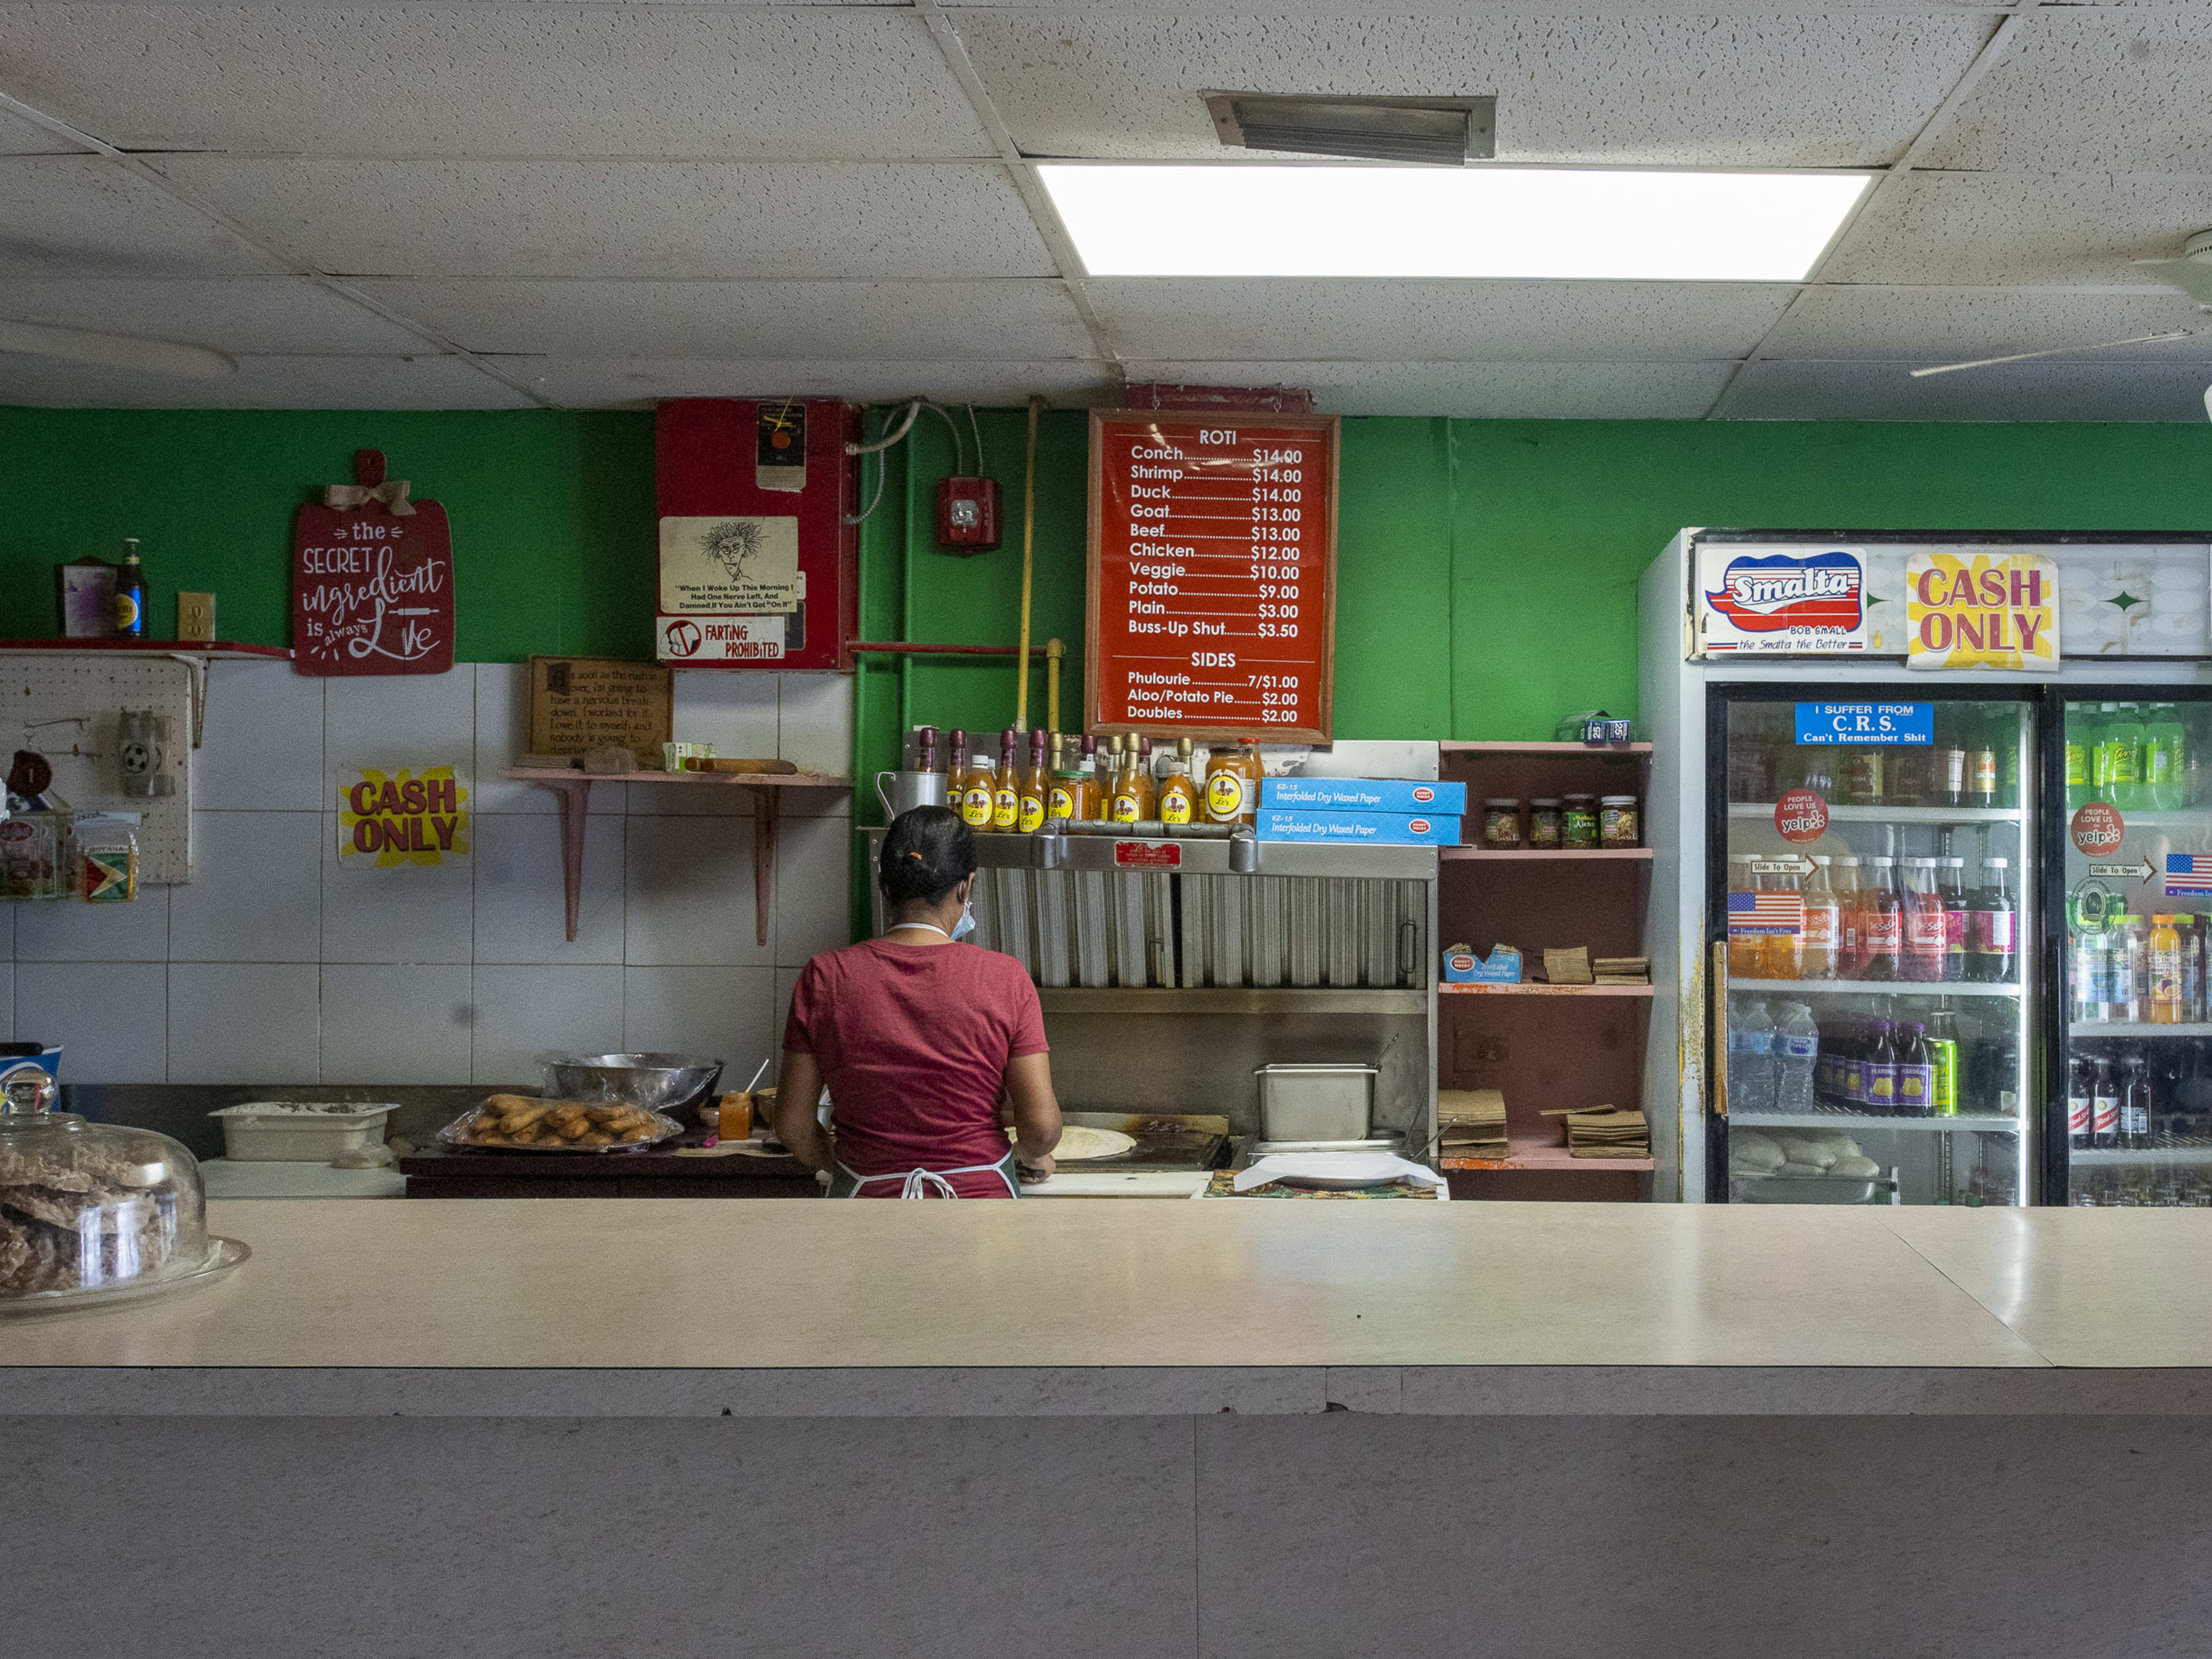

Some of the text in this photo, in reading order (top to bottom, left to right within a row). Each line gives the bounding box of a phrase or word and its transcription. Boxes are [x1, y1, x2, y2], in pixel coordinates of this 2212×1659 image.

[1199, 430, 1236, 445] ROTI
[1131, 446, 1302, 463] Conch $14.00
[1131, 465, 1301, 483] Shrimp $14.00
[1131, 486, 1301, 503] Duck $14.00
[1130, 505, 1300, 522] Goat $13.00
[353, 522, 385, 539] the
[1130, 524, 1300, 541] Beef $13.00
[304, 547, 372, 574] SECRET
[1130, 543, 1300, 561] Chicken $12.00
[1130, 562, 1299, 581] Veggie $10.00
[302, 546, 445, 626] ingredient
[1129, 582, 1298, 599] Potato $9.00
[1732, 567, 1851, 603] Smalta
[1917, 568, 2041, 608] CASH
[1129, 601, 1298, 619] Plain $3.00
[307, 618, 323, 636] is
[325, 623, 368, 646] always
[1129, 620, 1297, 638] Buss-Up Shut $3.50
[1790, 627, 1846, 635] BOB SMALL
[1919, 612, 2043, 652] ONLY
[1740, 639, 1847, 650] the Smalta the Better
[1191, 652, 1235, 668] SIDES
[1128, 672, 1298, 689] Phulourie 7/$1.00
[607, 685, 632, 696] going
[1128, 689, 1297, 706] Aloo/Potato Pie $2.00
[551, 695, 570, 704] have
[588, 707, 623, 717] worked
[627, 709, 638, 717] for
[1128, 706, 1297, 722] Doubles $2.00
[1816, 706, 1913, 714] I SUFFER FROM
[575, 721, 583, 729] it
[586, 721, 596, 729] to
[634, 722, 652, 730] and
[550, 732, 585, 742] nobody
[599, 735, 626, 747] going
[630, 733, 641, 741] to
[1804, 733, 1926, 742] Can't Remember Shit
[350, 779, 456, 816] CASH
[1277, 791, 1316, 802] Interfolded
[1317, 792, 1332, 804] Dry
[1334, 793, 1359, 802] Waxed
[1360, 793, 1381, 805] Paper
[1784, 802, 1804, 810] LOVE
[1272, 823, 1377, 836] Interfolded Dry Waxed Paper
[1781, 816, 1811, 833] yelp
[354, 816, 458, 853] ONLY
[2078, 830, 2107, 846] yelp
[1783, 864, 1800, 872] Open
